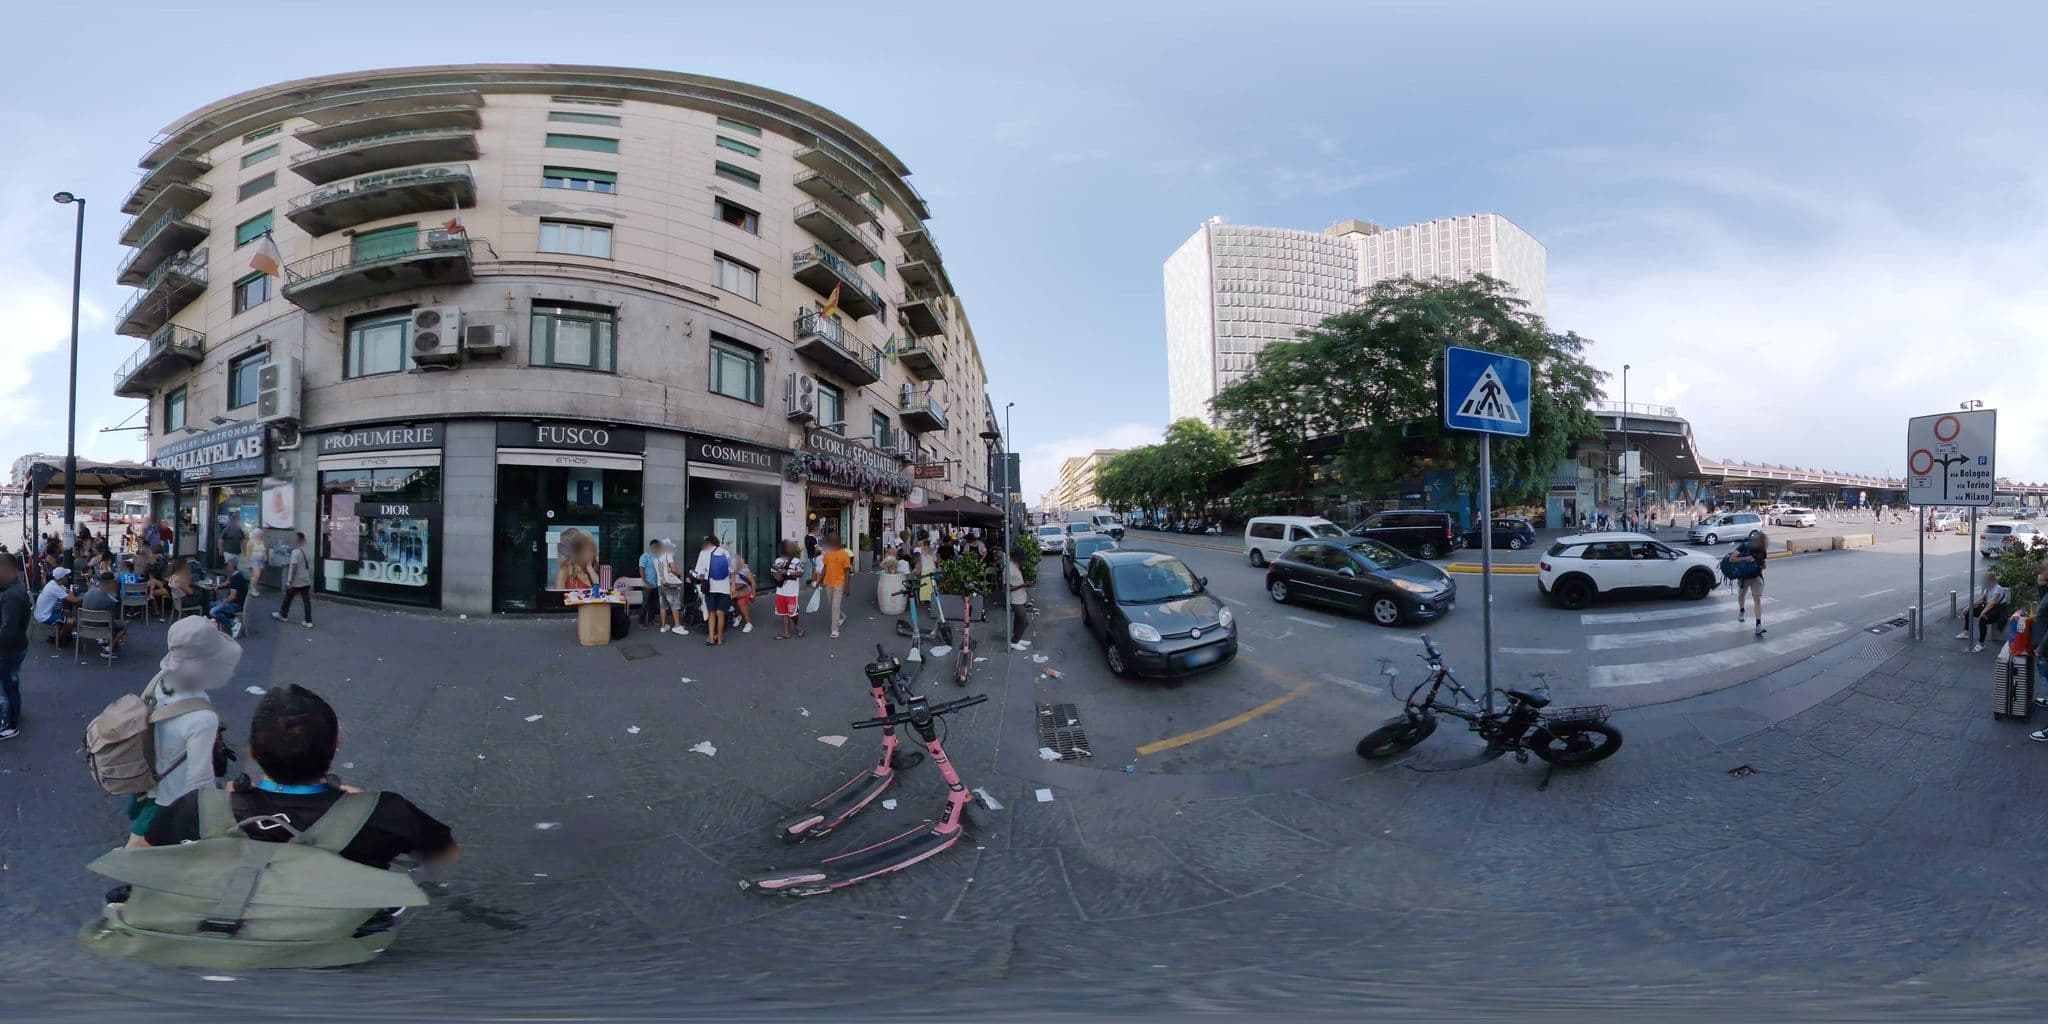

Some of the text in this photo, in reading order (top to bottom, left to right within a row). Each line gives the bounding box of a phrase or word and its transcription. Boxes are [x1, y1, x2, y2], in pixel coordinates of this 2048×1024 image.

[324, 428, 434, 449] PROFUMERIE
[537, 426, 609, 446] FUSCO
[811, 434, 844, 455] CUORI
[556, 456, 588, 465] ETHOS
[702, 444, 771, 466] COSMETICI
[1960, 469, 1990, 478] Bologna
[1966, 481, 1990, 489] Torino
[1965, 492, 1990, 501] Milano
[381, 505, 410, 515] DIOR
[360, 560, 425, 584] DIOR
